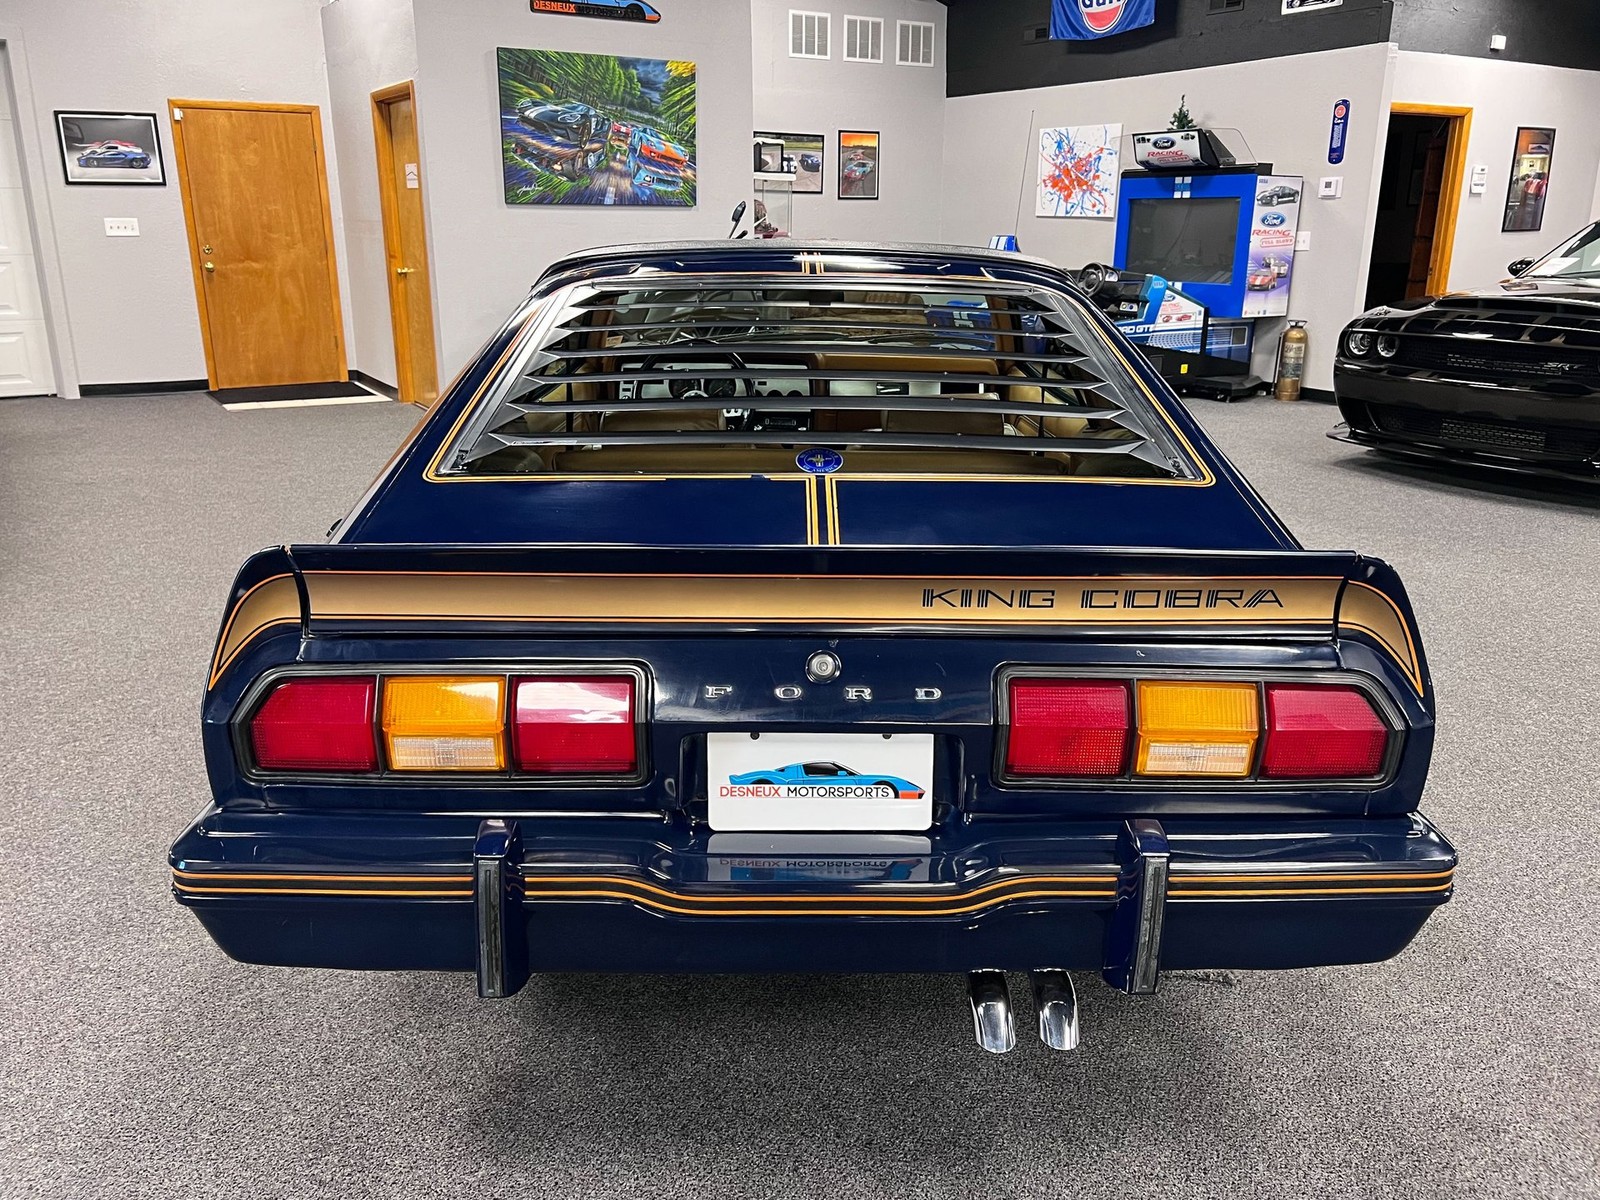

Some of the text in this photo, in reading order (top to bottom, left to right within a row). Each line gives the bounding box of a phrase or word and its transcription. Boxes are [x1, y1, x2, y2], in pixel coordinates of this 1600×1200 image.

[533, 0, 576, 13] DESNEUX
[1082, 0, 1121, 8] Gu
[1156, 139, 1172, 148] Ford
[1264, 213, 1282, 225] Ford
[922, 588, 1284, 609] KING COBRA
[705, 685, 942, 700] FORD
[719, 786, 890, 797] DESNEUX MOTORSPORTS
